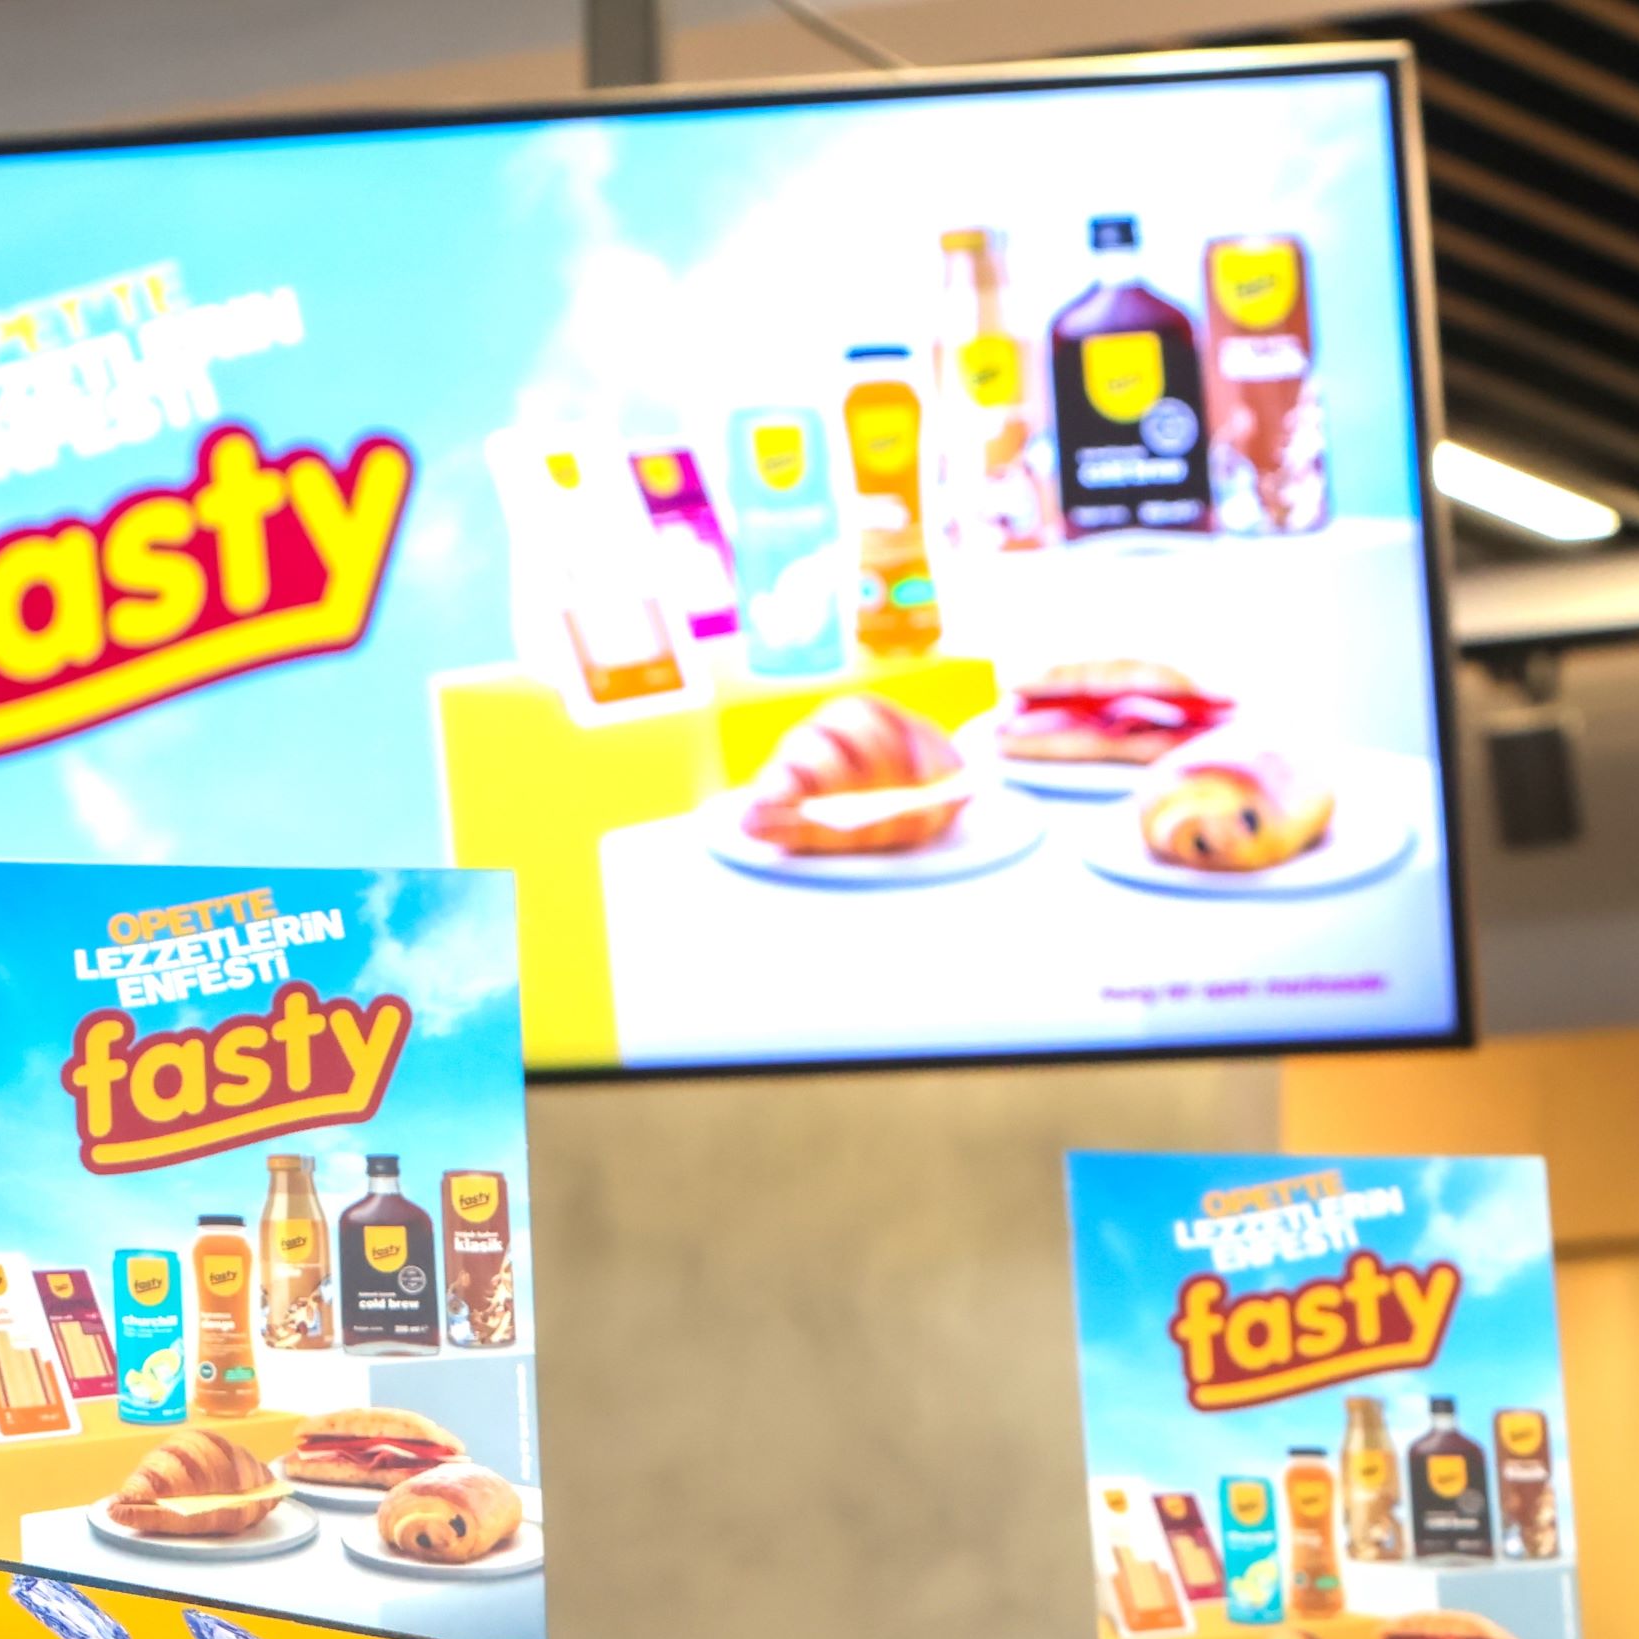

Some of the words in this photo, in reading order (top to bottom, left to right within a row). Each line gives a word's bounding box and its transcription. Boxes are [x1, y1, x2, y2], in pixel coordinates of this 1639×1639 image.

[107, 888, 278, 946] OPET'TE
[72, 991, 402, 1165] fasty
[1176, 1255, 1454, 1407] fasty
